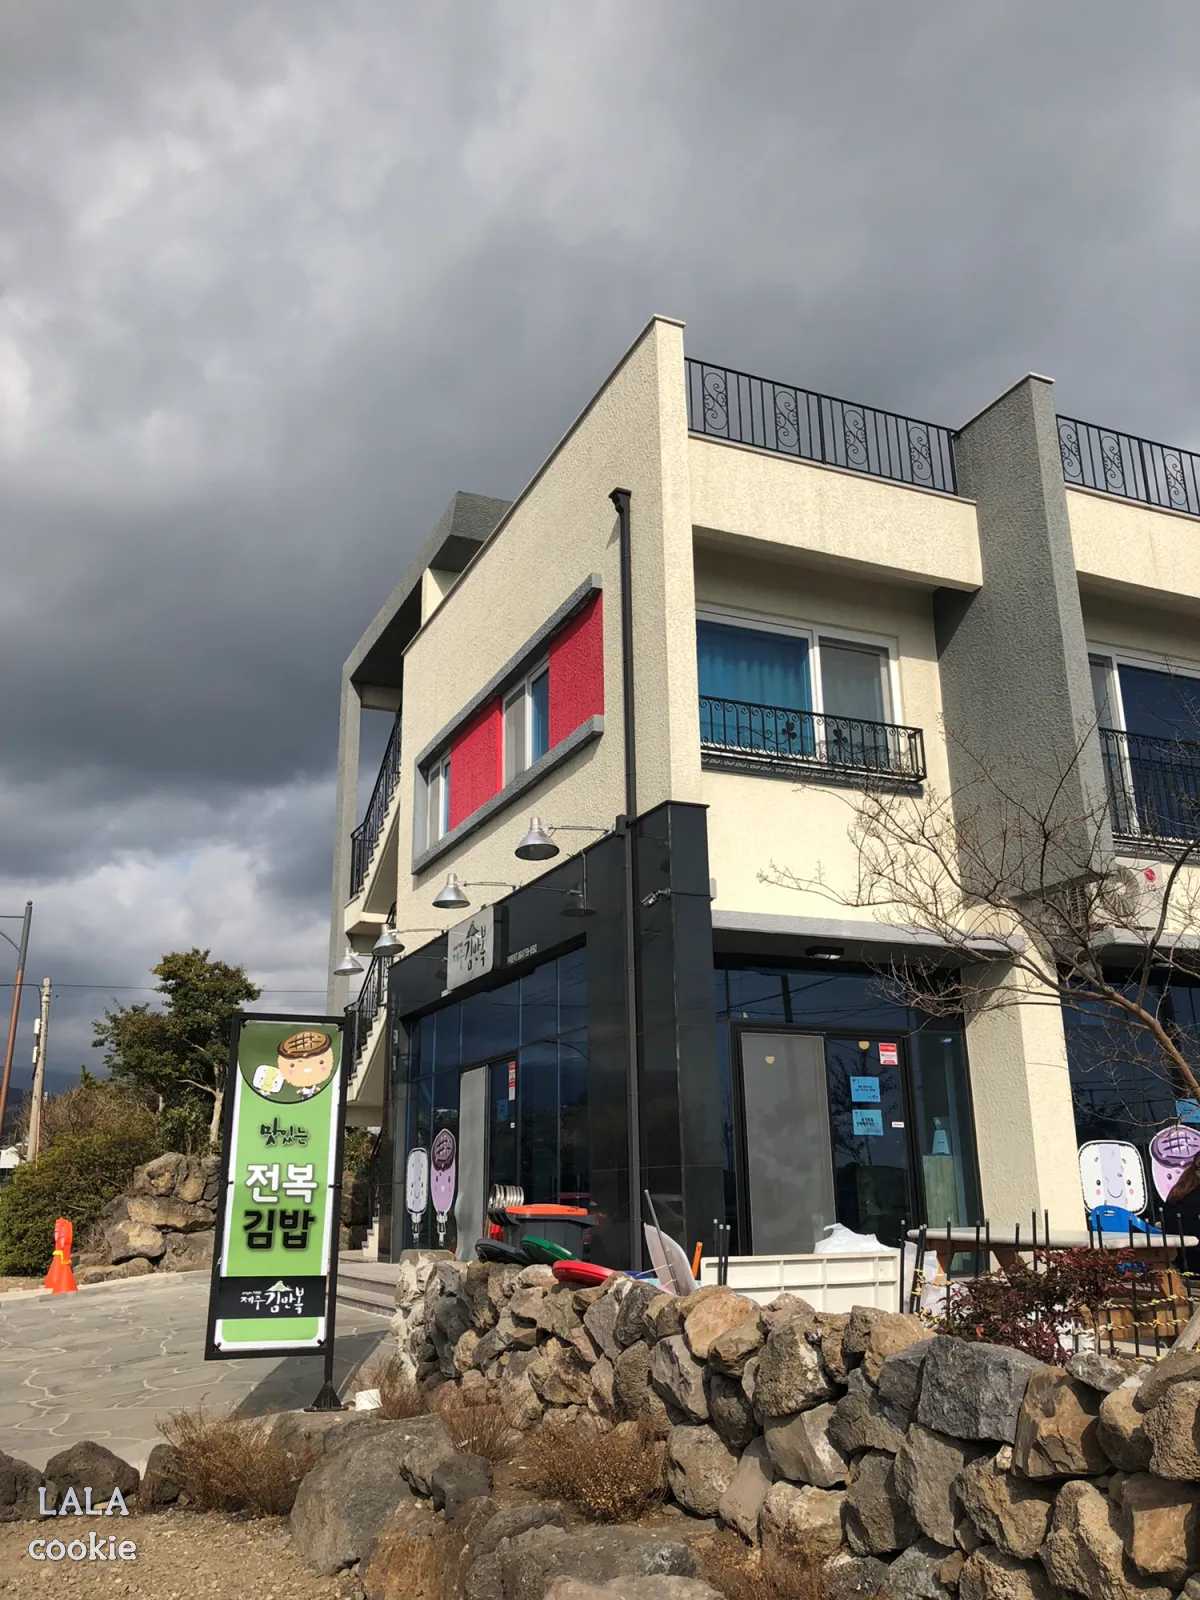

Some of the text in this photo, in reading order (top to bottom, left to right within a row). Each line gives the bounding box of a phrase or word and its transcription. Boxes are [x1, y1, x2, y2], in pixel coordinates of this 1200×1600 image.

[260, 1117, 308, 1146] 맛있는
[245, 1163, 318, 1204] 전복
[243, 1209, 316, 1250] 김밥
[264, 1286, 305, 1315] 김만복
